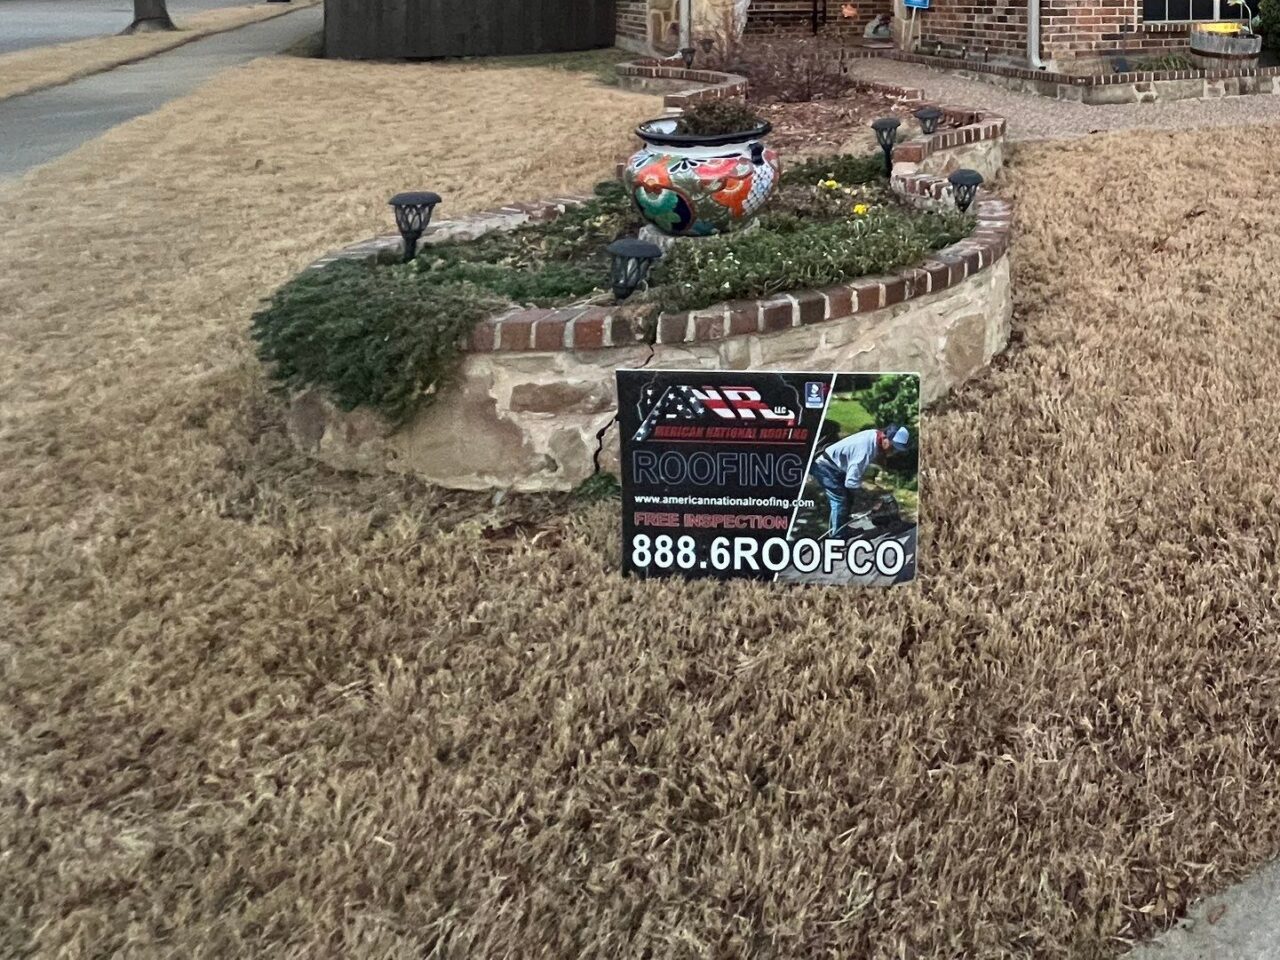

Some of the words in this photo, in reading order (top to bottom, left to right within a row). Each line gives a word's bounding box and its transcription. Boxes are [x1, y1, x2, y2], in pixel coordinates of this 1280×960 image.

[705, 427, 757, 439] NATIONAL
[759, 428, 808, 439] ROOFING
[633, 450, 803, 487] ROOFING
[634, 495, 815, 509] www.americannationalroofing.com
[634, 512, 680, 527] FREE
[683, 514, 788, 529] INSPECTION
[632, 534, 905, 576] 888.6ROOFCO
